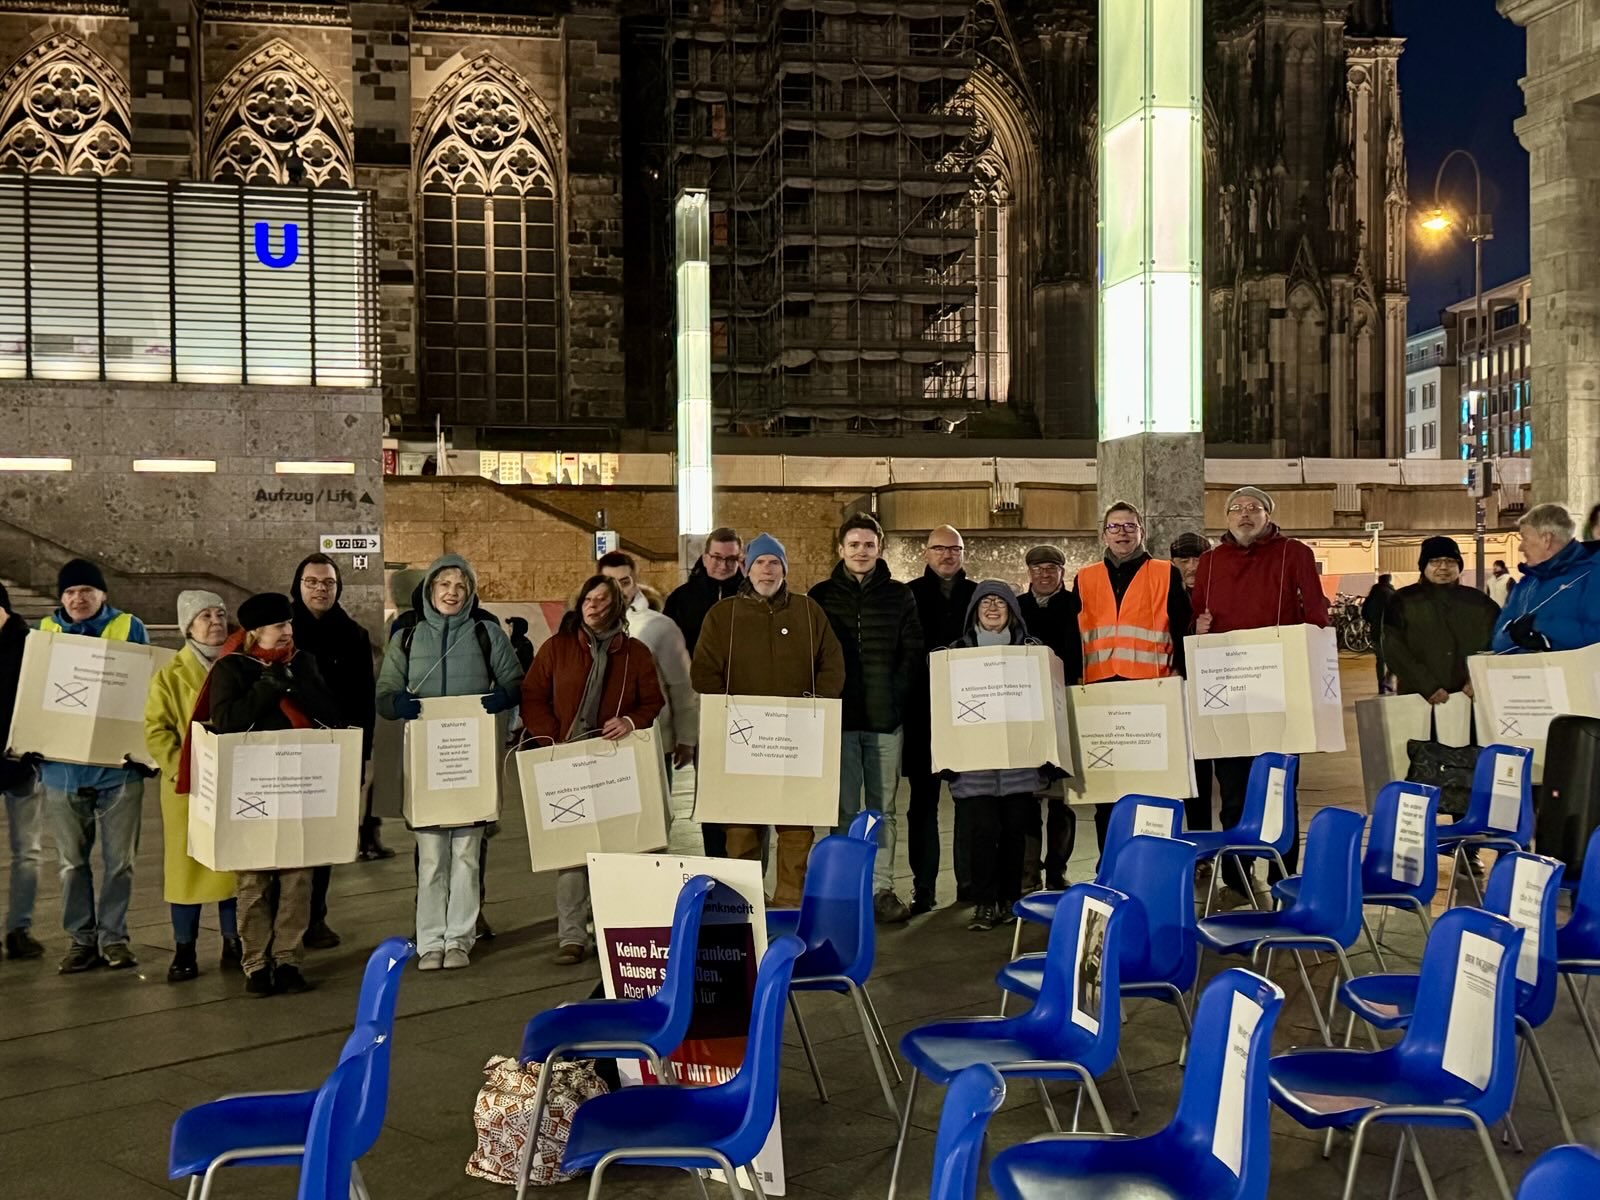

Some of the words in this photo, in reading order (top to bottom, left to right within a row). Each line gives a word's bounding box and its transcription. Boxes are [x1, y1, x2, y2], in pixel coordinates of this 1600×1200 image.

[254, 222, 298, 268] U
[255, 488, 314, 505] Aufzug
[327, 489, 354, 502] Lift
[336, 540, 350, 548] 172
[353, 540, 367, 548] 173
[572, 760, 597, 768] Wahlurne
[580, 781, 605, 790] verbergen
[703, 903, 754, 915] enknecht
[616, 942, 647, 958] Keine
[650, 940, 671, 959] Ärz
[696, 944, 747, 961] ranken-
[619, 962, 656, 980] häuser
[623, 983, 645, 999] Aber
[686, 1063, 712, 1083] MIT
